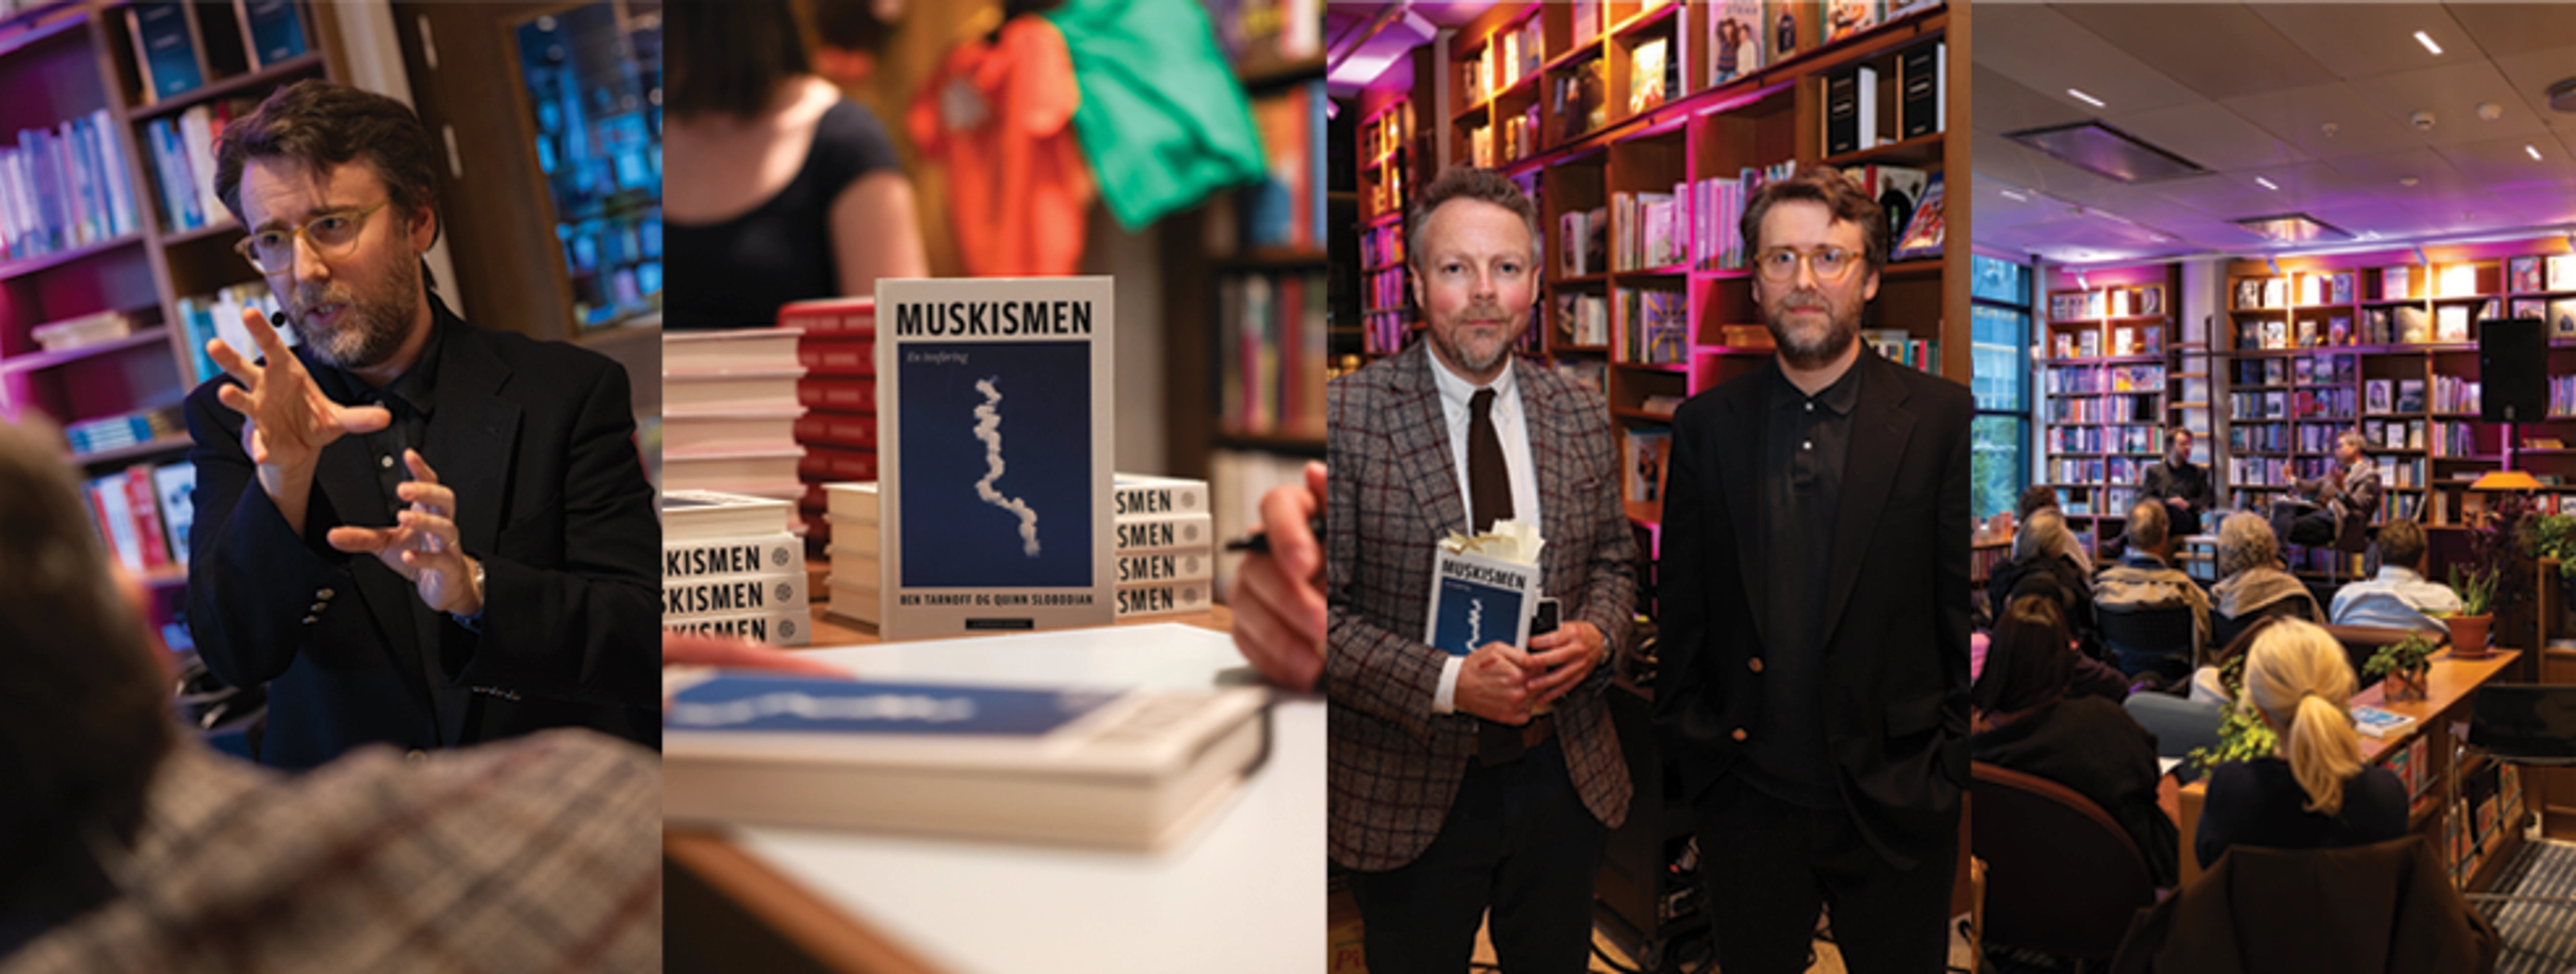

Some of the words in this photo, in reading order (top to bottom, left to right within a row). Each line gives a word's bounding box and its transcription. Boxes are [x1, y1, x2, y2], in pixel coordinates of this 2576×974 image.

[896, 301, 1091, 335] MUSKISMEN
[663, 545, 760, 577] KISMEN
[1442, 558, 1527, 590] MUSKISMEN
[900, 594, 921, 605] BEN
[924, 594, 971, 605] TARNOFF
